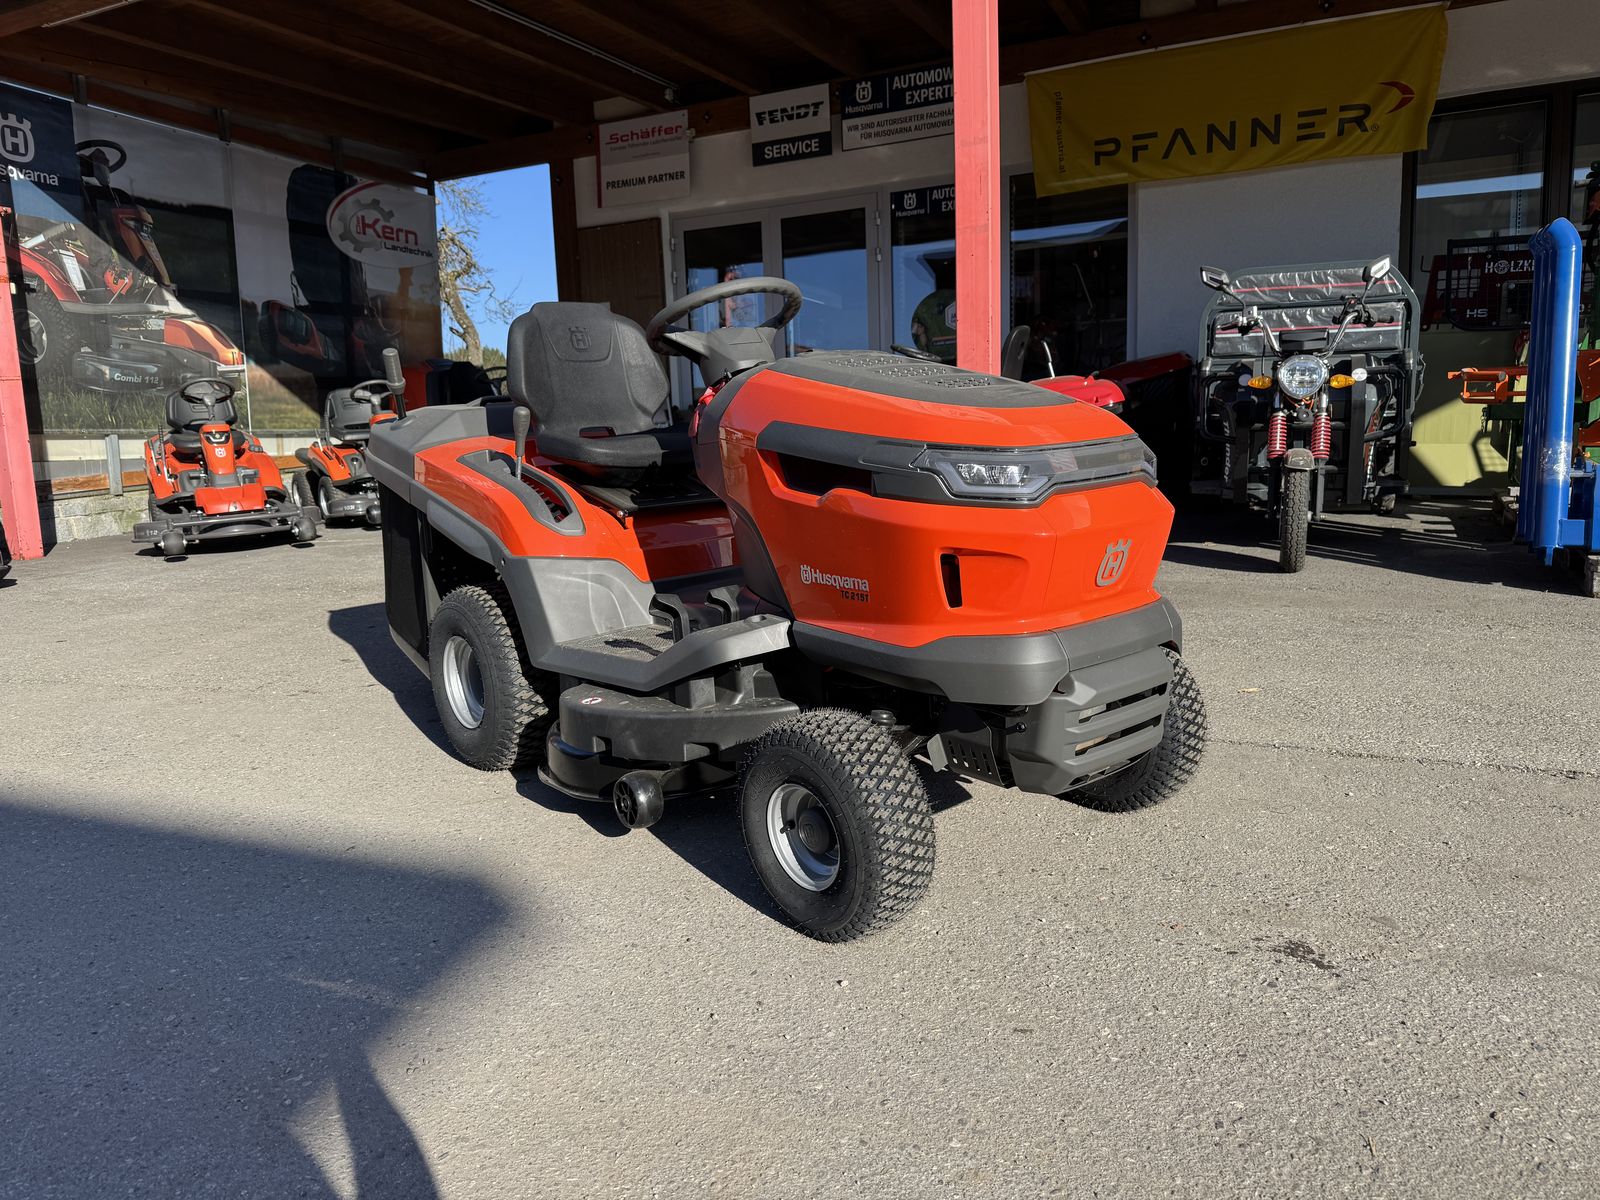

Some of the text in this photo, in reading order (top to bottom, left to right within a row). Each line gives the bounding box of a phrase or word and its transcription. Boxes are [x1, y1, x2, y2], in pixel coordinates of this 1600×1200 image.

[755, 101, 824, 126] FENDT
[845, 102, 884, 114] Husqvarna
[846, 124, 860, 133] WIR
[860, 121, 876, 131] SIND
[876, 114, 925, 128] AUTORISIERTER
[860, 131, 873, 141] FÜR
[873, 125, 912, 138] HUSQVARNA
[605, 125, 682, 145] Schäffer
[1093, 103, 1372, 166] PFANNER
[764, 138, 820, 159] SERVICE
[606, 170, 686, 190] PREMIUM PARTNER
[941, 200, 955, 212] EX
[361, 215, 418, 246] Kern
[383, 241, 434, 258] Landtechnik
[1485, 259, 1535, 274] HOLZK
[114, 373, 159, 384] Combi 112
[811, 568, 869, 592] Husqvarna
[841, 590, 850, 599] TC
